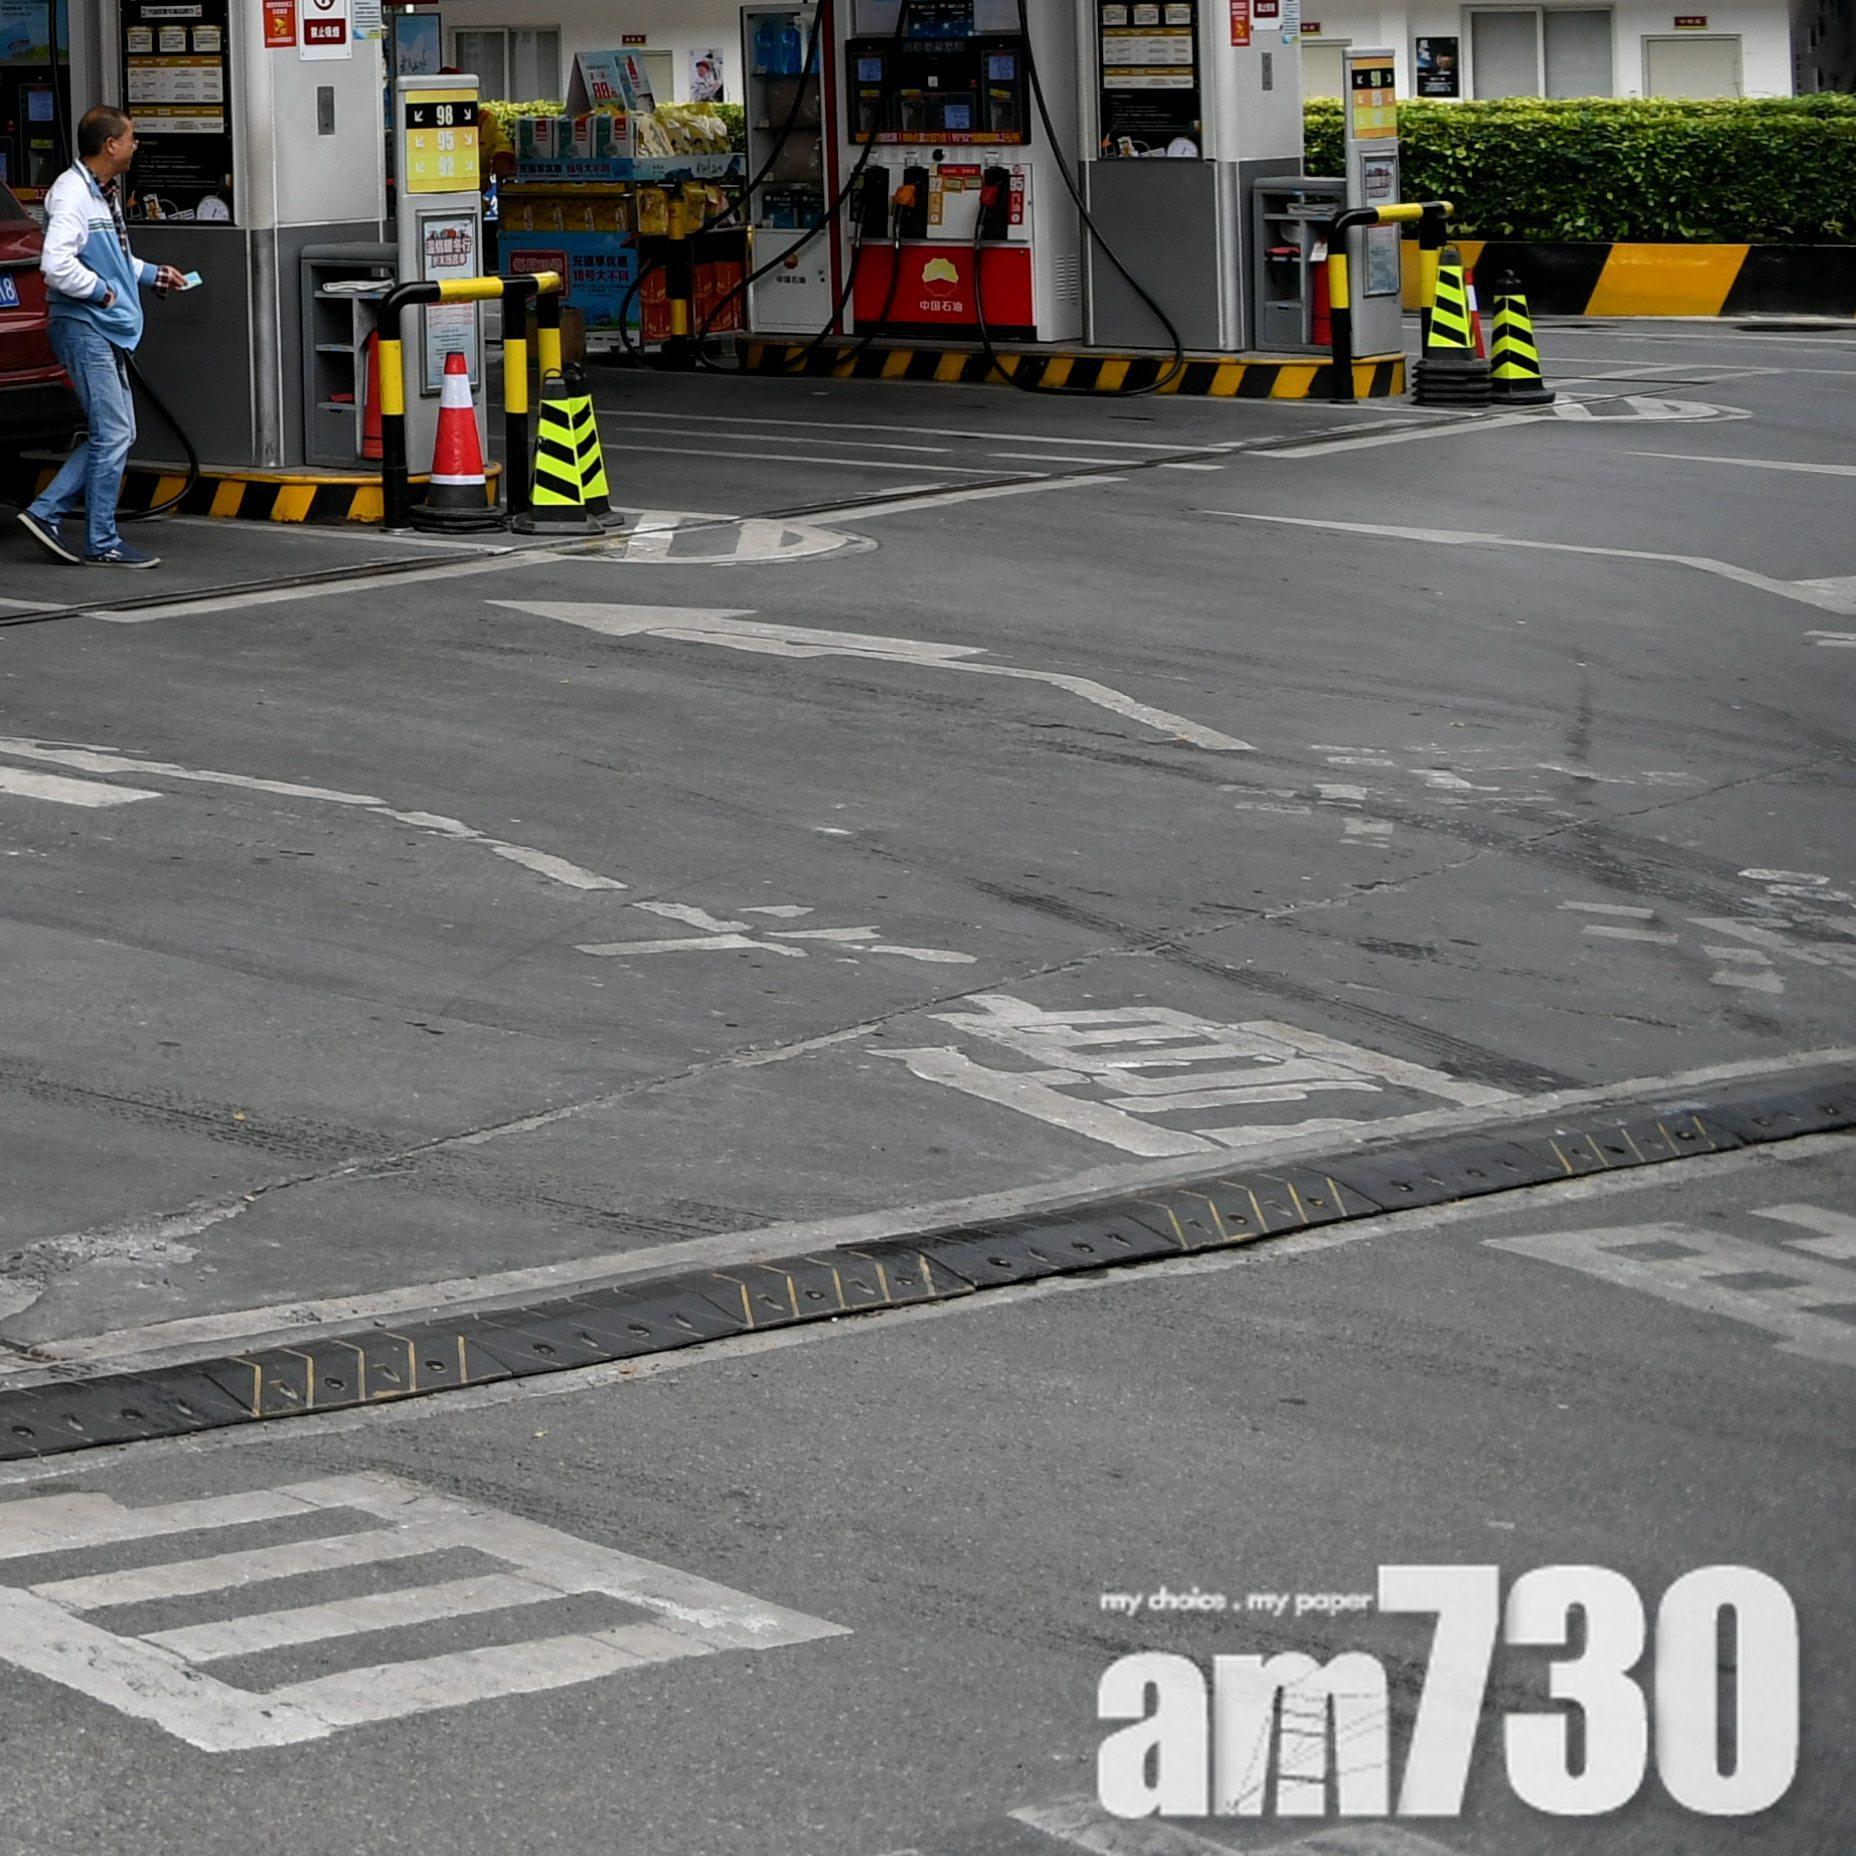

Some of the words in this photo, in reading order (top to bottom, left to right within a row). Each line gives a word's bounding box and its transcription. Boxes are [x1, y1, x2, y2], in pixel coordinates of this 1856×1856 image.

[435, 104, 453, 126] 98
[437, 131, 455, 151] 95
[919, 299, 963, 313] 中国石油
